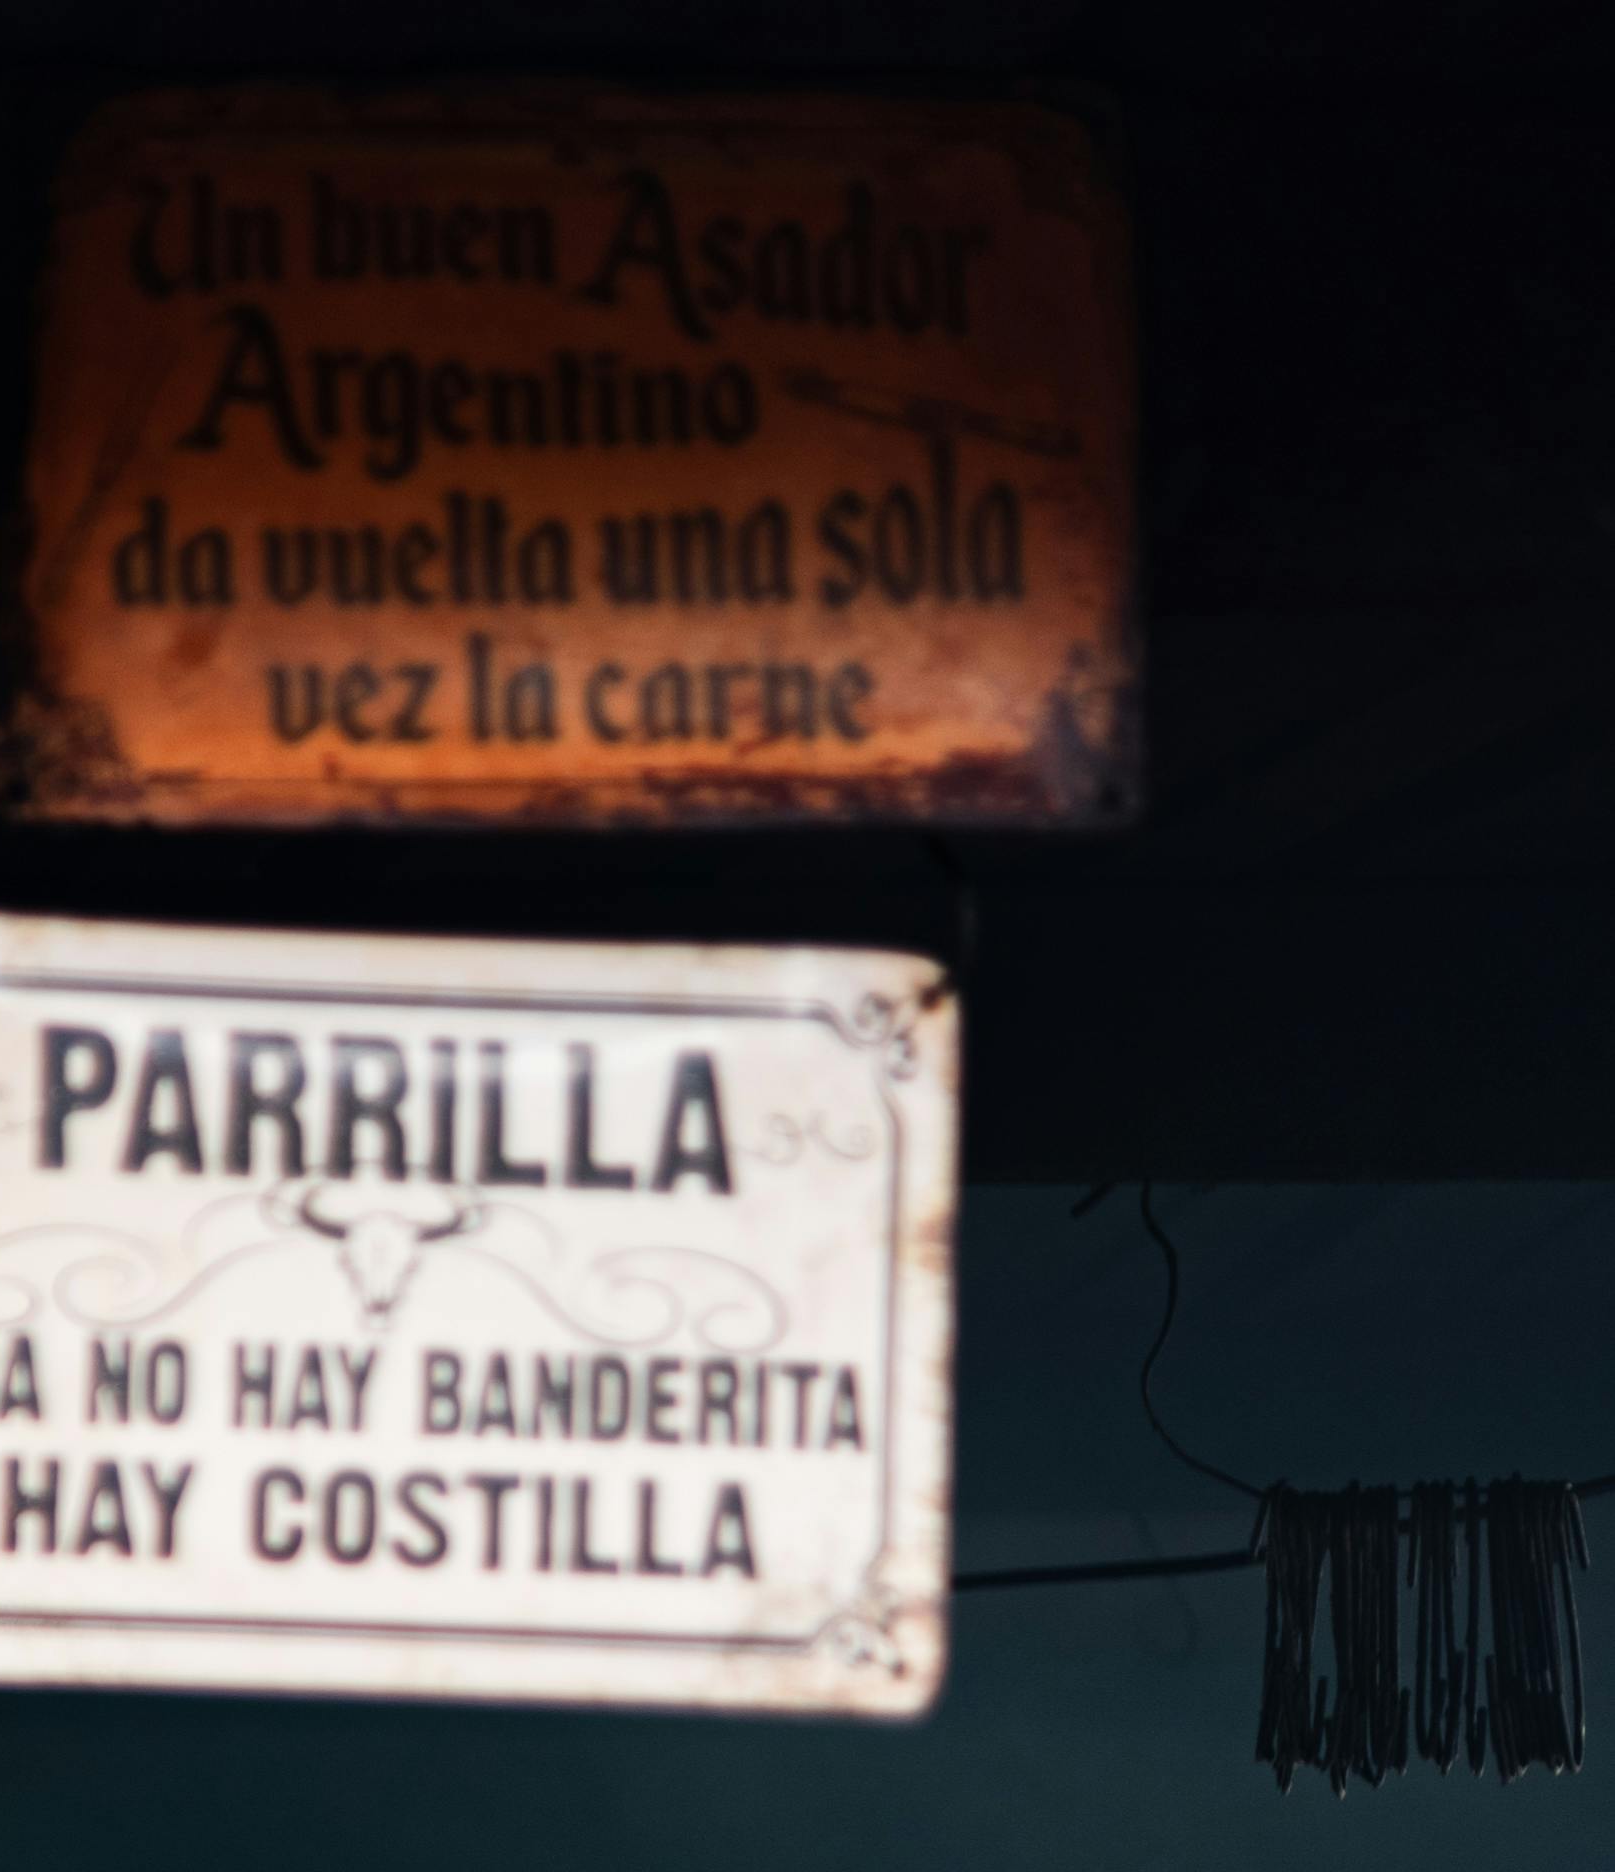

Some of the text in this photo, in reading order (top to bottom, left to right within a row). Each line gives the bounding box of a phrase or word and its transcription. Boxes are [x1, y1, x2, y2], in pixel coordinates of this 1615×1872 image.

[128, 168, 988, 342] Un buen Asador
[180, 302, 760, 480] Argentino
[110, 425, 1028, 610] da vuelta una sola
[267, 630, 878, 745] vez la carne
[34, 1024, 736, 1195] PARRILLA
[86, 1338, 190, 1426] NO
[230, 1344, 378, 1434] HAY
[418, 1350, 868, 1452] BANDERITA
[0, 1457, 760, 1580] HAY COSTILLA
